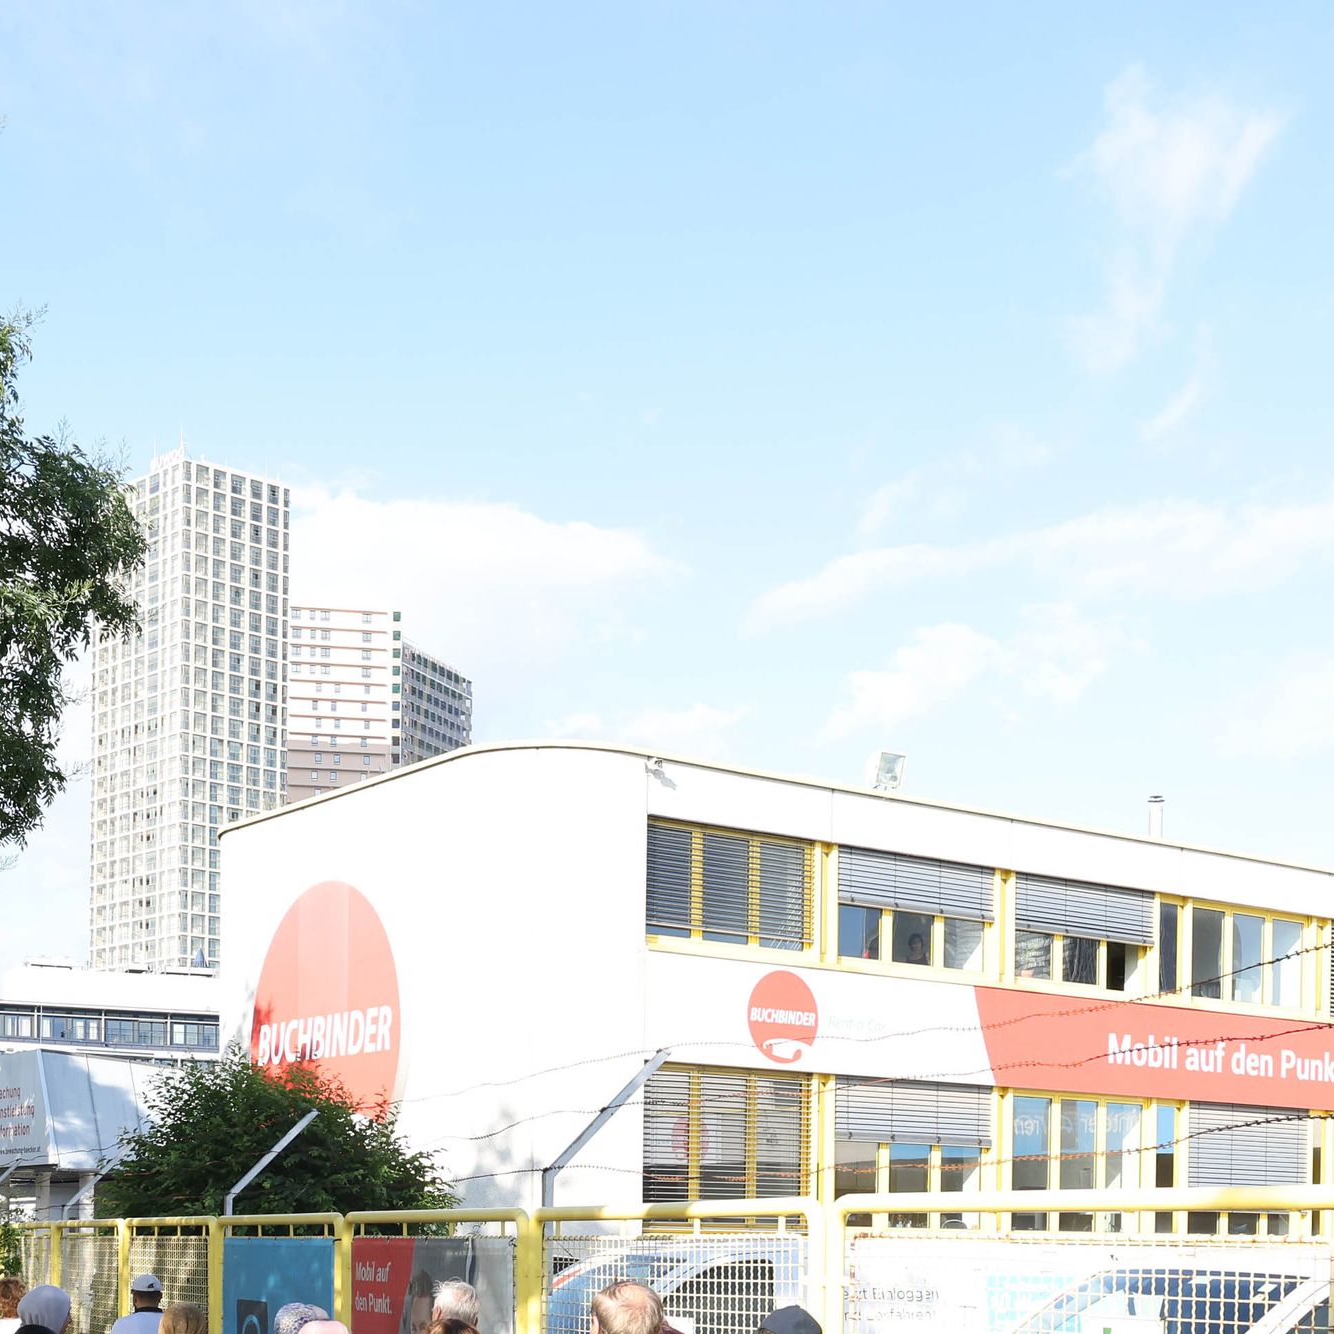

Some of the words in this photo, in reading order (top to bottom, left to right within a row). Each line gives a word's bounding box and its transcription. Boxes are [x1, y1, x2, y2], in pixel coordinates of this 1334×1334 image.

[750, 1007, 816, 1027] BUCHBINDER
[258, 1005, 393, 1066] BUCHBINDER
[1107, 1033, 1178, 1070] Mobil
[1185, 1042, 1227, 1073] auf
[1231, 1043, 1273, 1077] den
[355, 1261, 375, 1281] Mobil
[377, 1262, 392, 1283] auf
[355, 1291, 367, 1312] den
[369, 1293, 392, 1314] Punkt.
[873, 1286, 939, 1302] Einloggen
